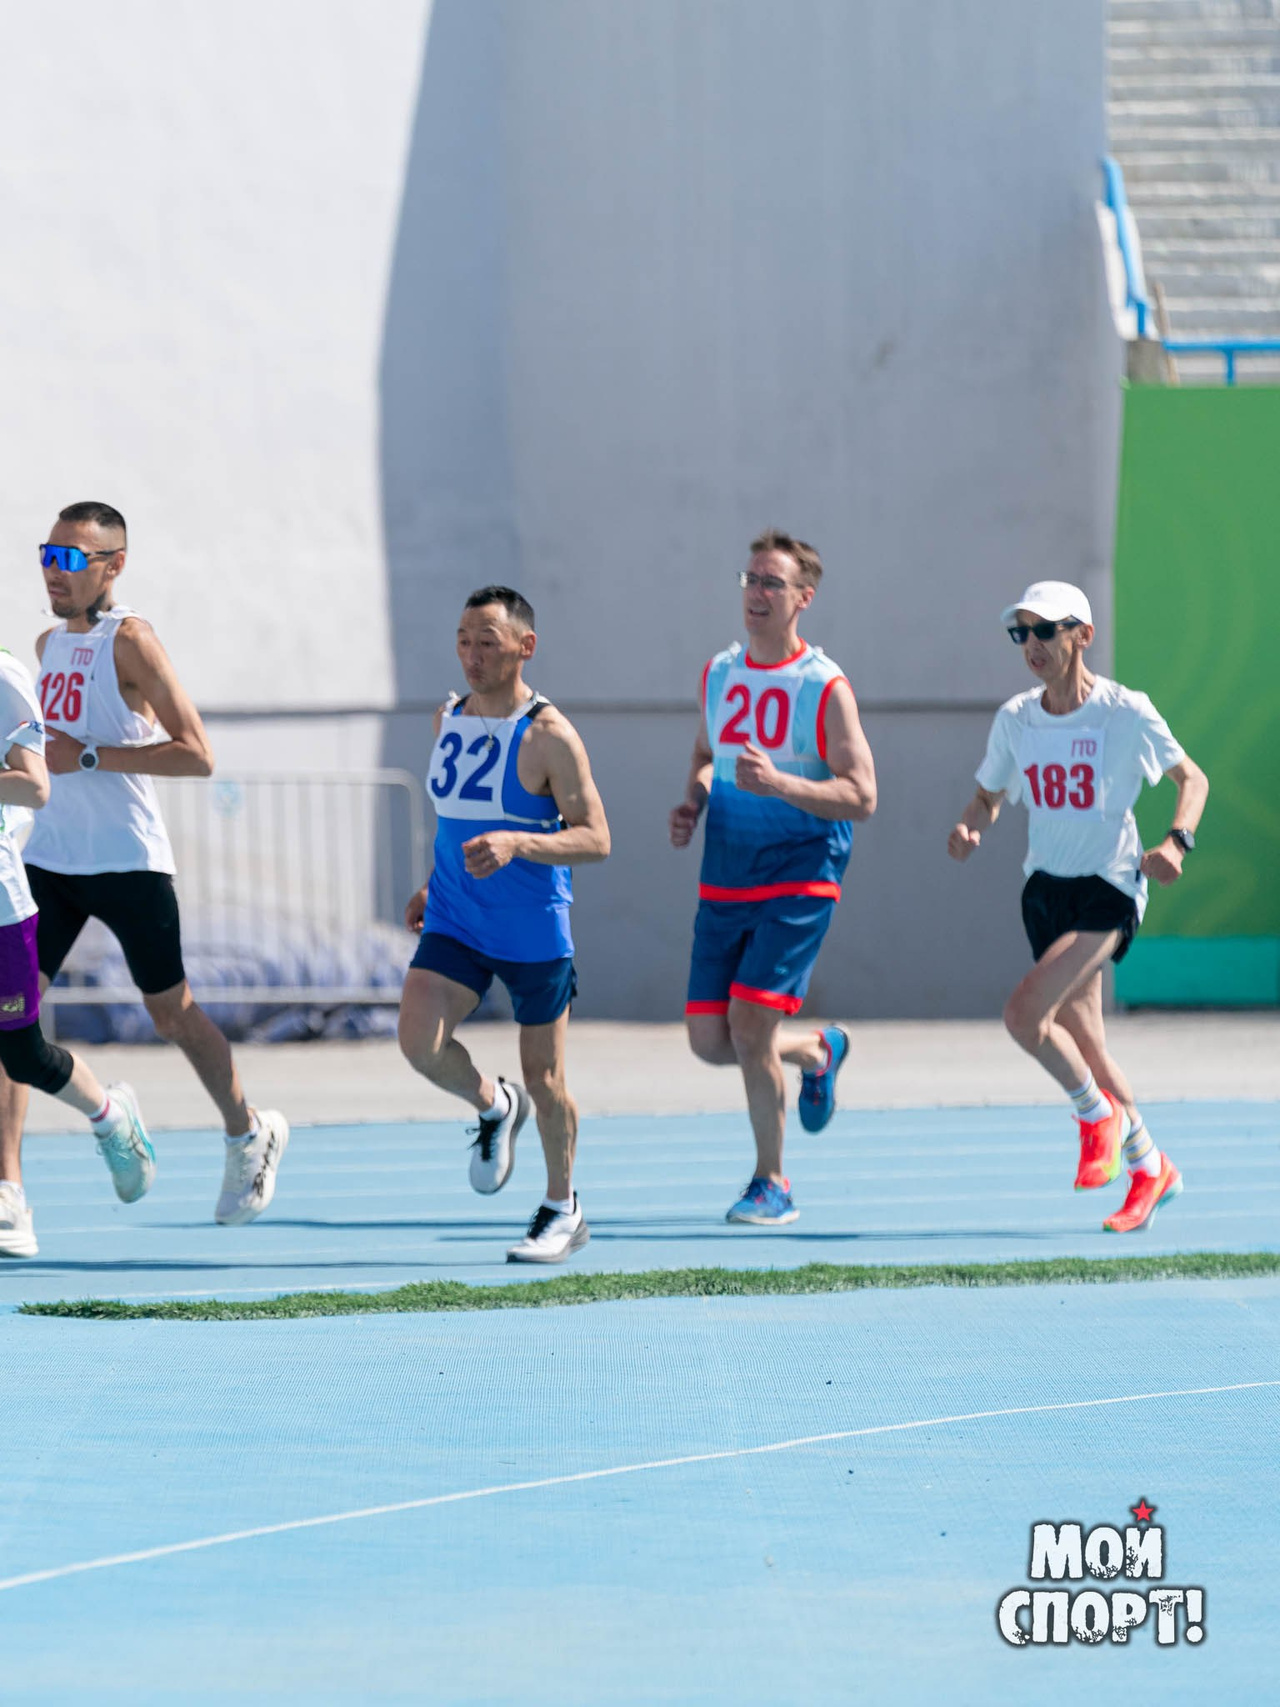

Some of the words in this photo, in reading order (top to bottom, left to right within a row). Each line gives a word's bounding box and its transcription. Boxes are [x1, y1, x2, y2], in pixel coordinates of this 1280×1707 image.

[40, 671, 85, 723] 126
[718, 684, 791, 749] 20
[431, 732, 502, 802] 32
[1023, 763, 1096, 811] 183
